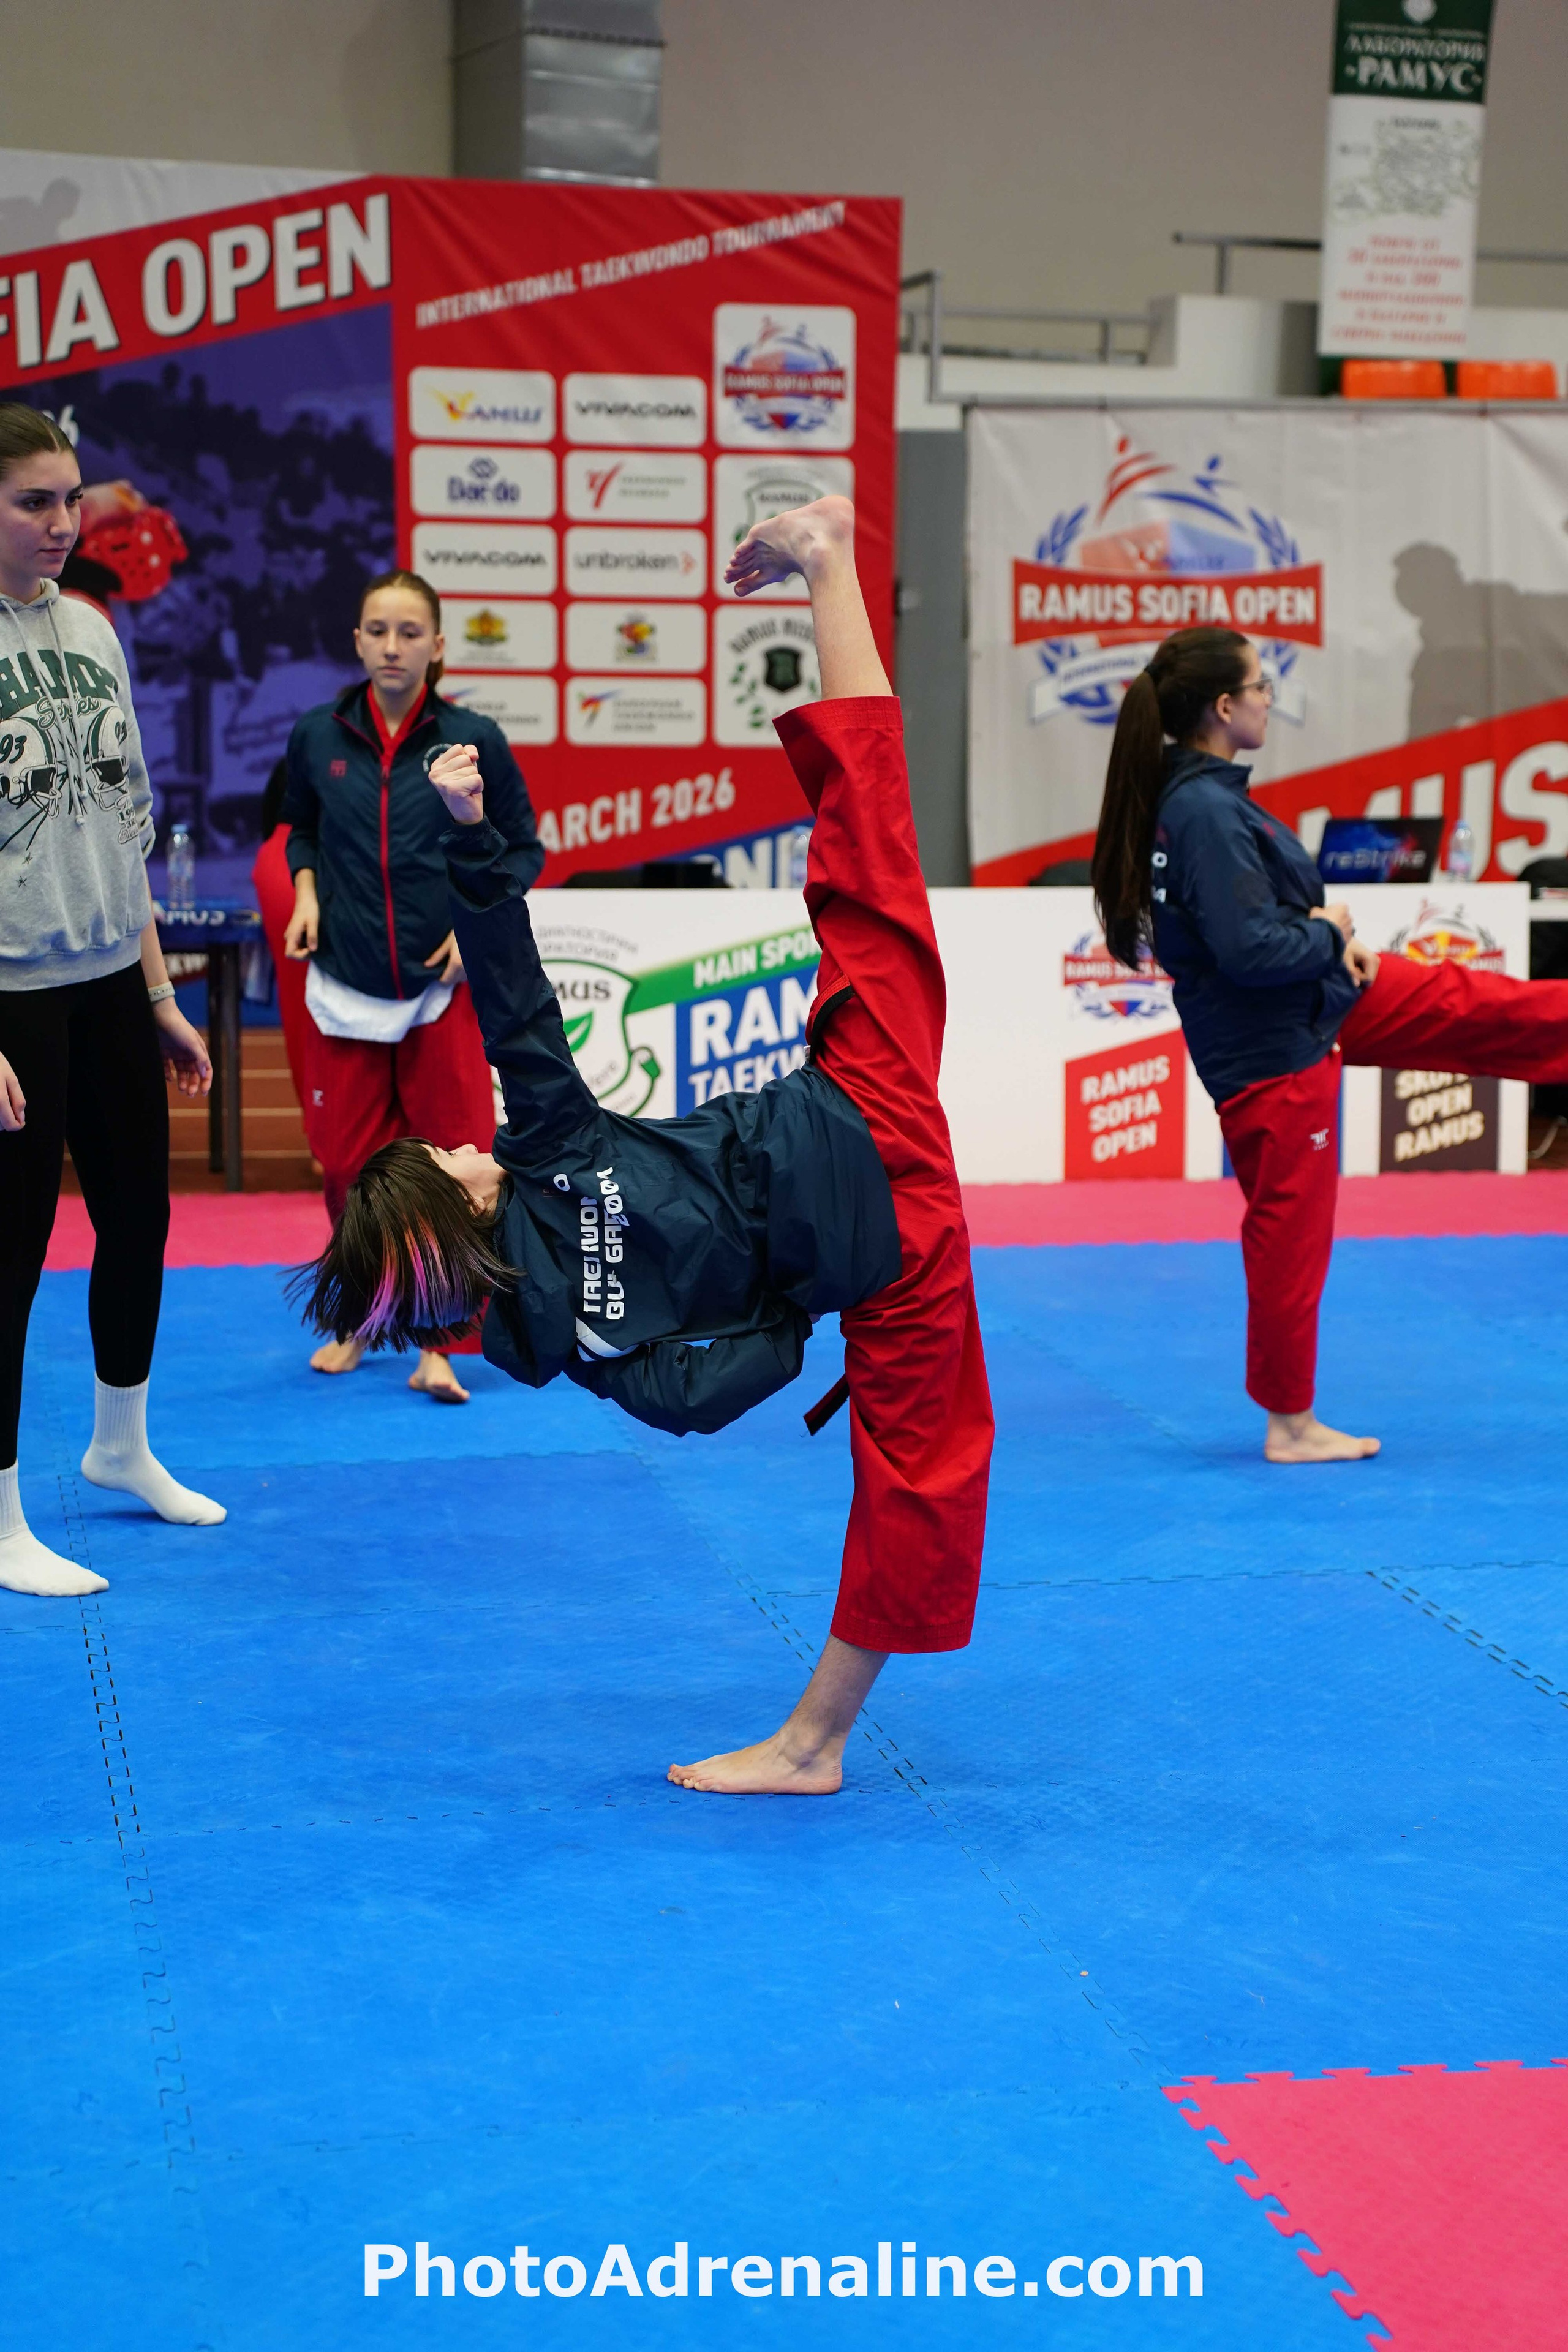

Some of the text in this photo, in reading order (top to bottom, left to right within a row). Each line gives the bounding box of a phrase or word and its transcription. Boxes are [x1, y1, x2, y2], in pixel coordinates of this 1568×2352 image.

[1357, 56, 1475, 94] РАМУС
[0, 192, 392, 369] IA OPEN
[416, 200, 846, 330] INTERNATIONAL TAEKWONDO TOURNAMENT
[573, 401, 698, 419] VIVACOM
[425, 549, 548, 567] VIVACOM
[574, 549, 679, 570] unbroken
[1019, 582, 1317, 624] RAMUS SOFIA OPEN
[537, 766, 736, 854] ARCH 2026
[693, 946, 757, 988] MAIN
[554, 980, 611, 1001] MUS
[690, 973, 818, 1067] RAM
[688, 1044, 807, 1106] TAEKW
[1081, 1054, 1170, 1105] RAMUS
[1088, 1089, 1162, 1133] SOFIA
[1406, 1082, 1473, 1128] OPEN
[1091, 1119, 1158, 1164] OPEN
[1394, 1110, 1485, 1163] RAMUS
